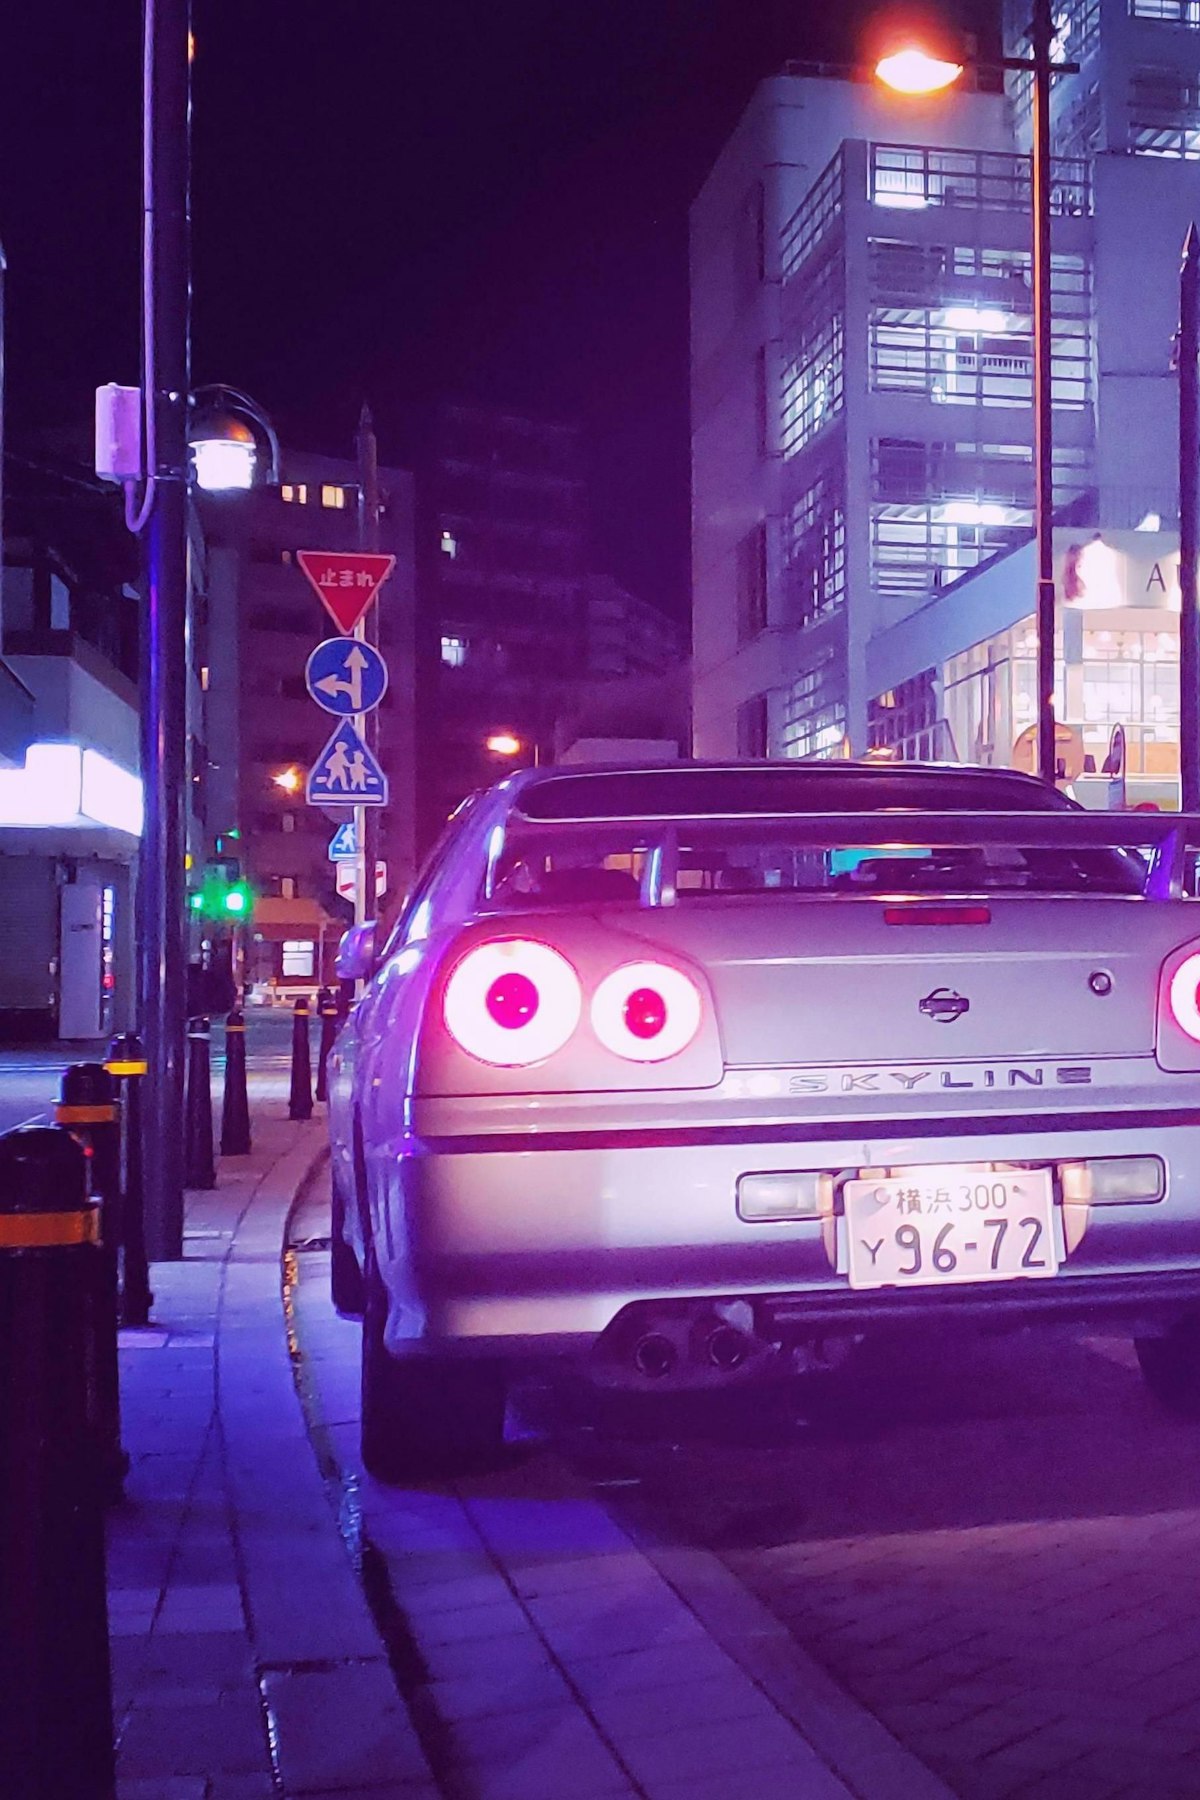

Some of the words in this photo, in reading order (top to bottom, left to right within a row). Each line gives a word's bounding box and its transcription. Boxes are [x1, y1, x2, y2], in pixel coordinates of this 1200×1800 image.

[318, 567, 375, 588] 止まれ
[789, 1066, 1092, 1094] SKYLINE
[896, 1187, 952, 1215] 横浜
[958, 1182, 1008, 1212] 300
[860, 1238, 885, 1265] Y
[894, 1216, 1046, 1275] 96-72
